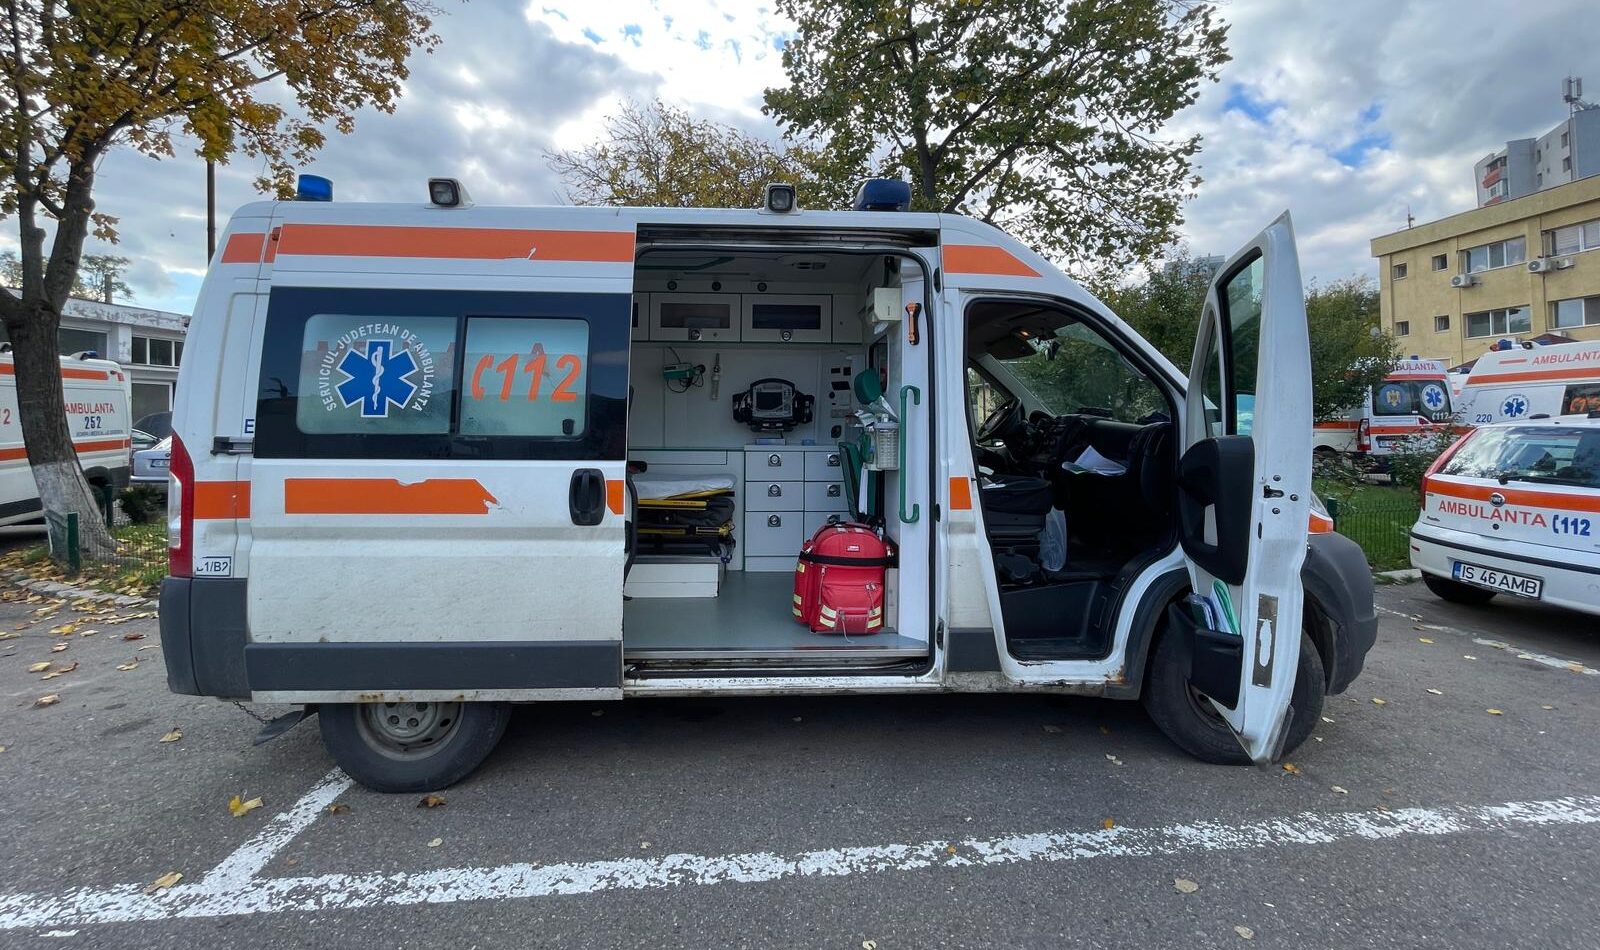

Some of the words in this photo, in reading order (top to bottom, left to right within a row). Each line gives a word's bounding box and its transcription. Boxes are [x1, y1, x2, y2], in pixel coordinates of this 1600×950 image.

[319, 350, 339, 412] SERVICIUL
[337, 323, 400, 349] JUDETEAN
[400, 329, 417, 344] DE
[411, 341, 435, 412] AMBULANTA
[495, 353, 582, 401] 112
[64, 402, 115, 414] AMBULANTA
[84, 415, 102, 429] 252
[1476, 413, 1493, 423] 220
[1438, 499, 1547, 528] AMBULANTA
[1561, 516, 1591, 537] 112
[1462, 565, 1475, 580] IS
[1480, 570, 1497, 585] 46
[1498, 574, 1538, 594] AMB
